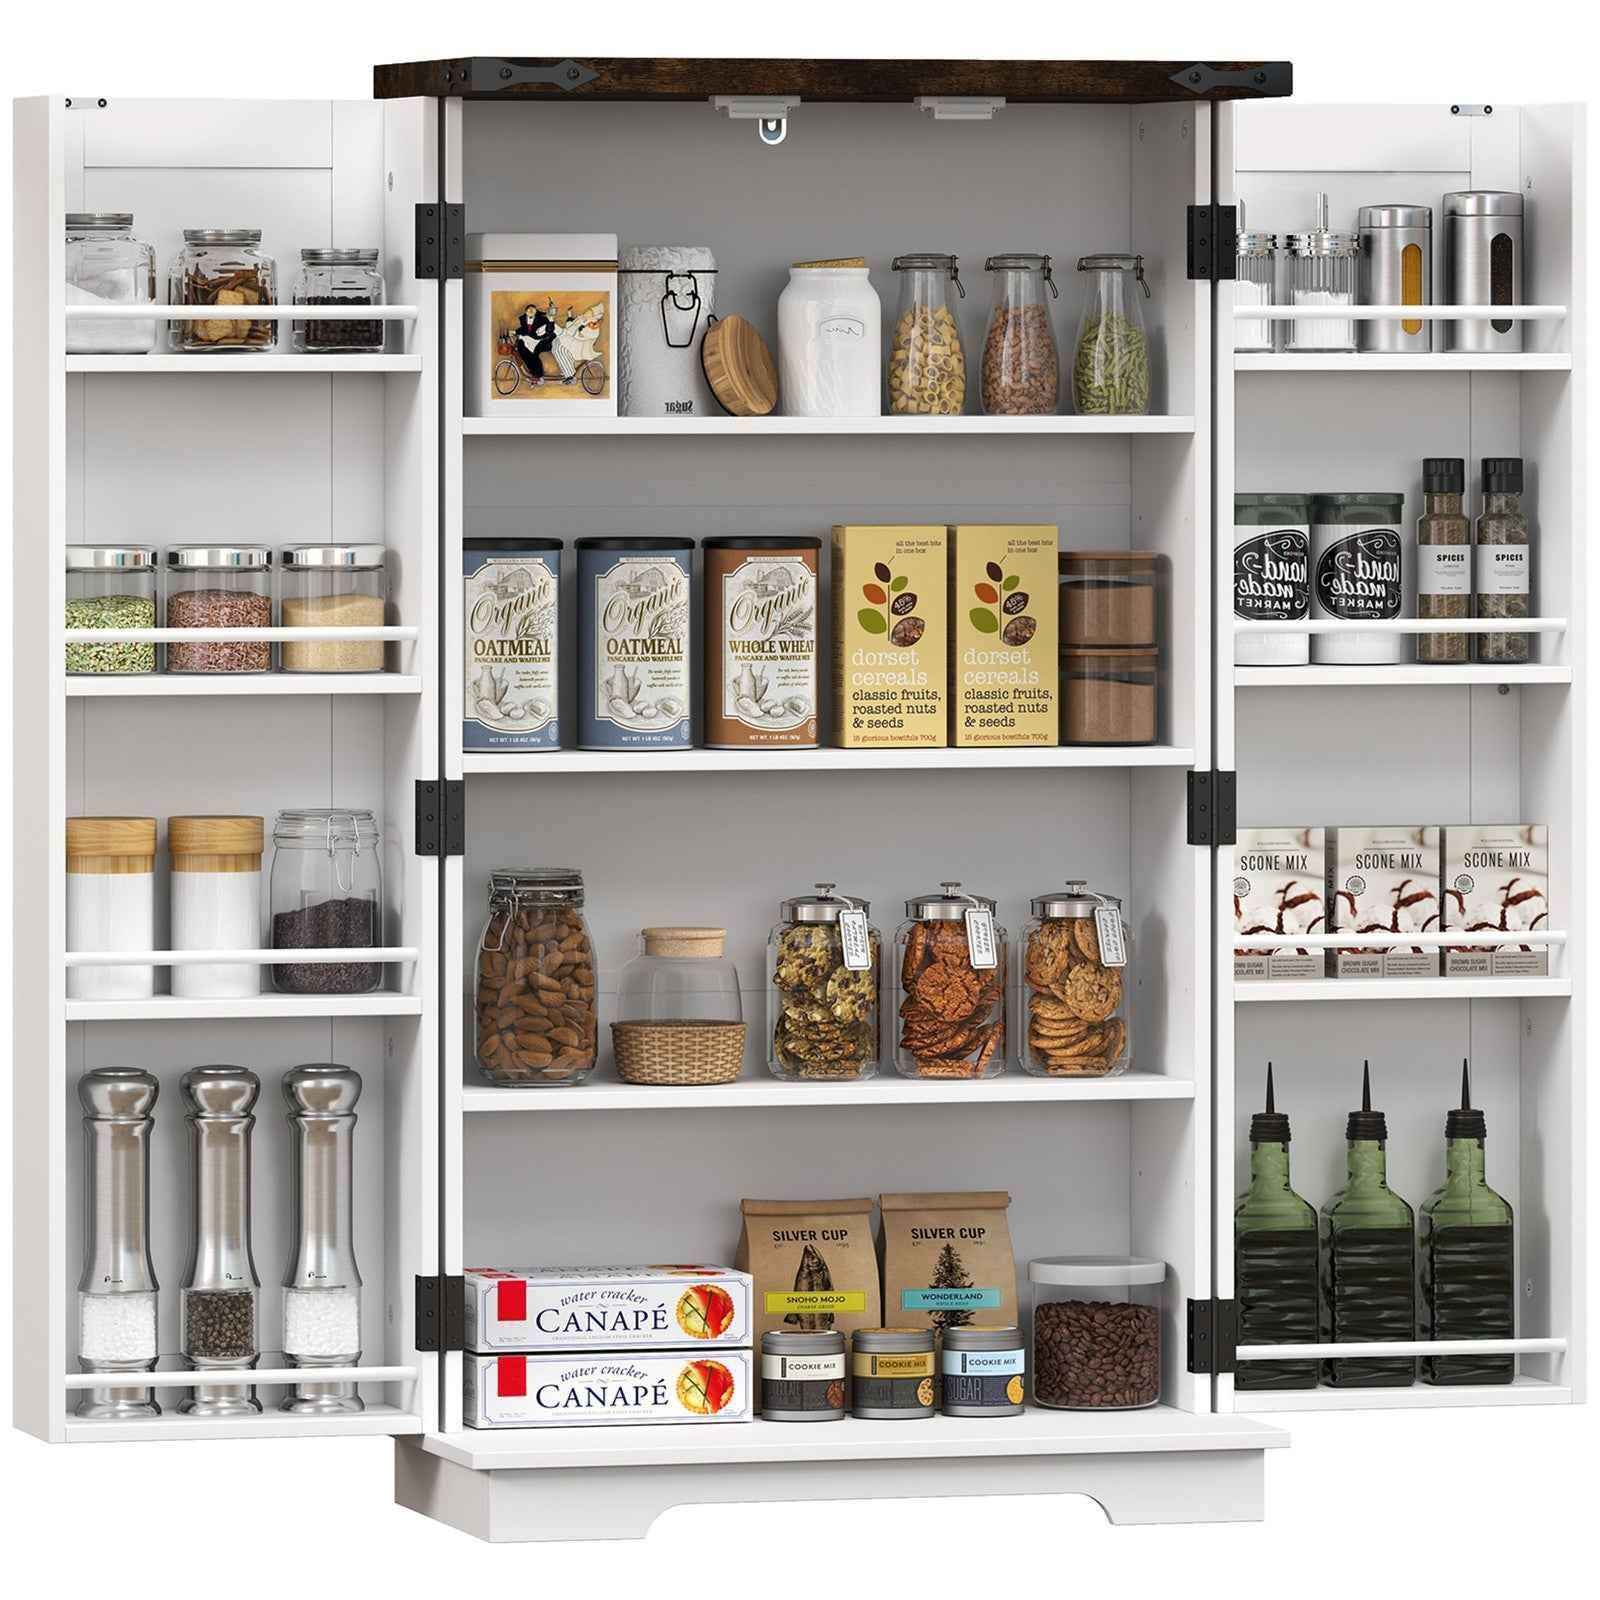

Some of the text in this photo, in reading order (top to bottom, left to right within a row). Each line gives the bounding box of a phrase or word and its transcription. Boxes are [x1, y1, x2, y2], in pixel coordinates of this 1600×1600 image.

[1436, 553, 1465, 562] SPICES
[1495, 553, 1523, 561] SPICES
[470, 576, 549, 635] Organic
[602, 576, 682, 635] Organic
[730, 575, 809, 639] Organic
[474, 639, 551, 656] OATMEAL
[607, 638, 683, 655] OATMEAL
[728, 640, 814, 653] WHOLE WHEAT
[852, 648, 919, 666] dorset
[963, 648, 1031, 665] dorset
[852, 669, 928, 686] cereals
[963, 667, 1040, 685] cereals
[852, 689, 941, 702] classic fruits,
[964, 688, 1053, 701] classic fruits,
[852, 703, 937, 714] roasted nuts
[964, 702, 1049, 713] roasted nuts
[852, 717, 904, 728] & seeds
[964, 716, 1016, 727] & seeds
[1240, 855, 1308, 871] SCONE MIX
[1355, 853, 1423, 869] SCONE MIX
[1464, 852, 1531, 868] SCONE MIX
[772, 1229, 848, 1242] SILVER CUP
[911, 1227, 986, 1239] SILVER CUP
[560, 1288, 648, 1307] water cracker
[786, 1296, 818, 1304] SNOHO
[921, 1293, 984, 1301] WONDERLAND
[535, 1303, 670, 1333] CANAPÉ
[788, 1363, 821, 1371] COOKIE
[879, 1360, 927, 1368] COOKIE MIX
[560, 1364, 648, 1383] water cracker
[535, 1378, 670, 1409] CANAPÉ
[947, 1376, 983, 1401] SUGAR
